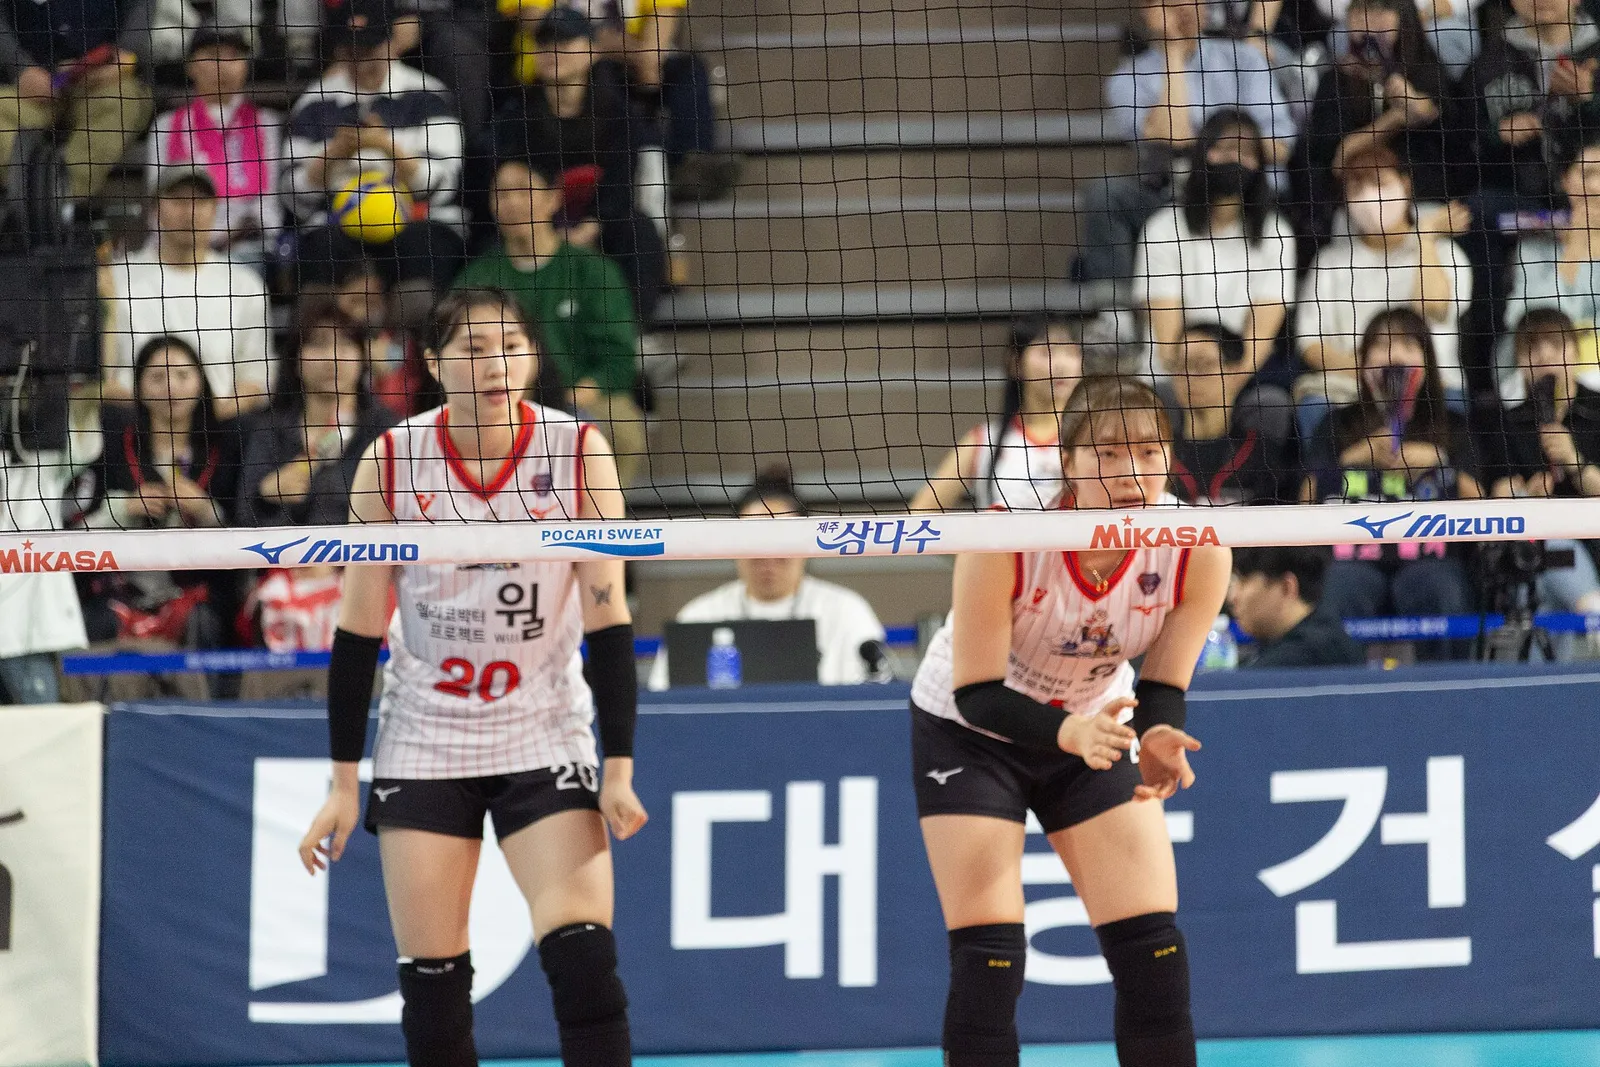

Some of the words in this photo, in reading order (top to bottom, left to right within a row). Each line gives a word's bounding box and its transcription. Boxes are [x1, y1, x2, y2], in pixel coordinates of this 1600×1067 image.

[541, 529, 602, 542] POCARI
[607, 528, 663, 541] SWEAT
[816, 521, 840, 534] 제주
[834, 520, 942, 555] 삼다수
[1091, 517, 1221, 548] MIKASA
[1403, 514, 1525, 538] MIZUNO
[298, 539, 419, 563] MIZUNO
[433, 656, 522, 704] 20
